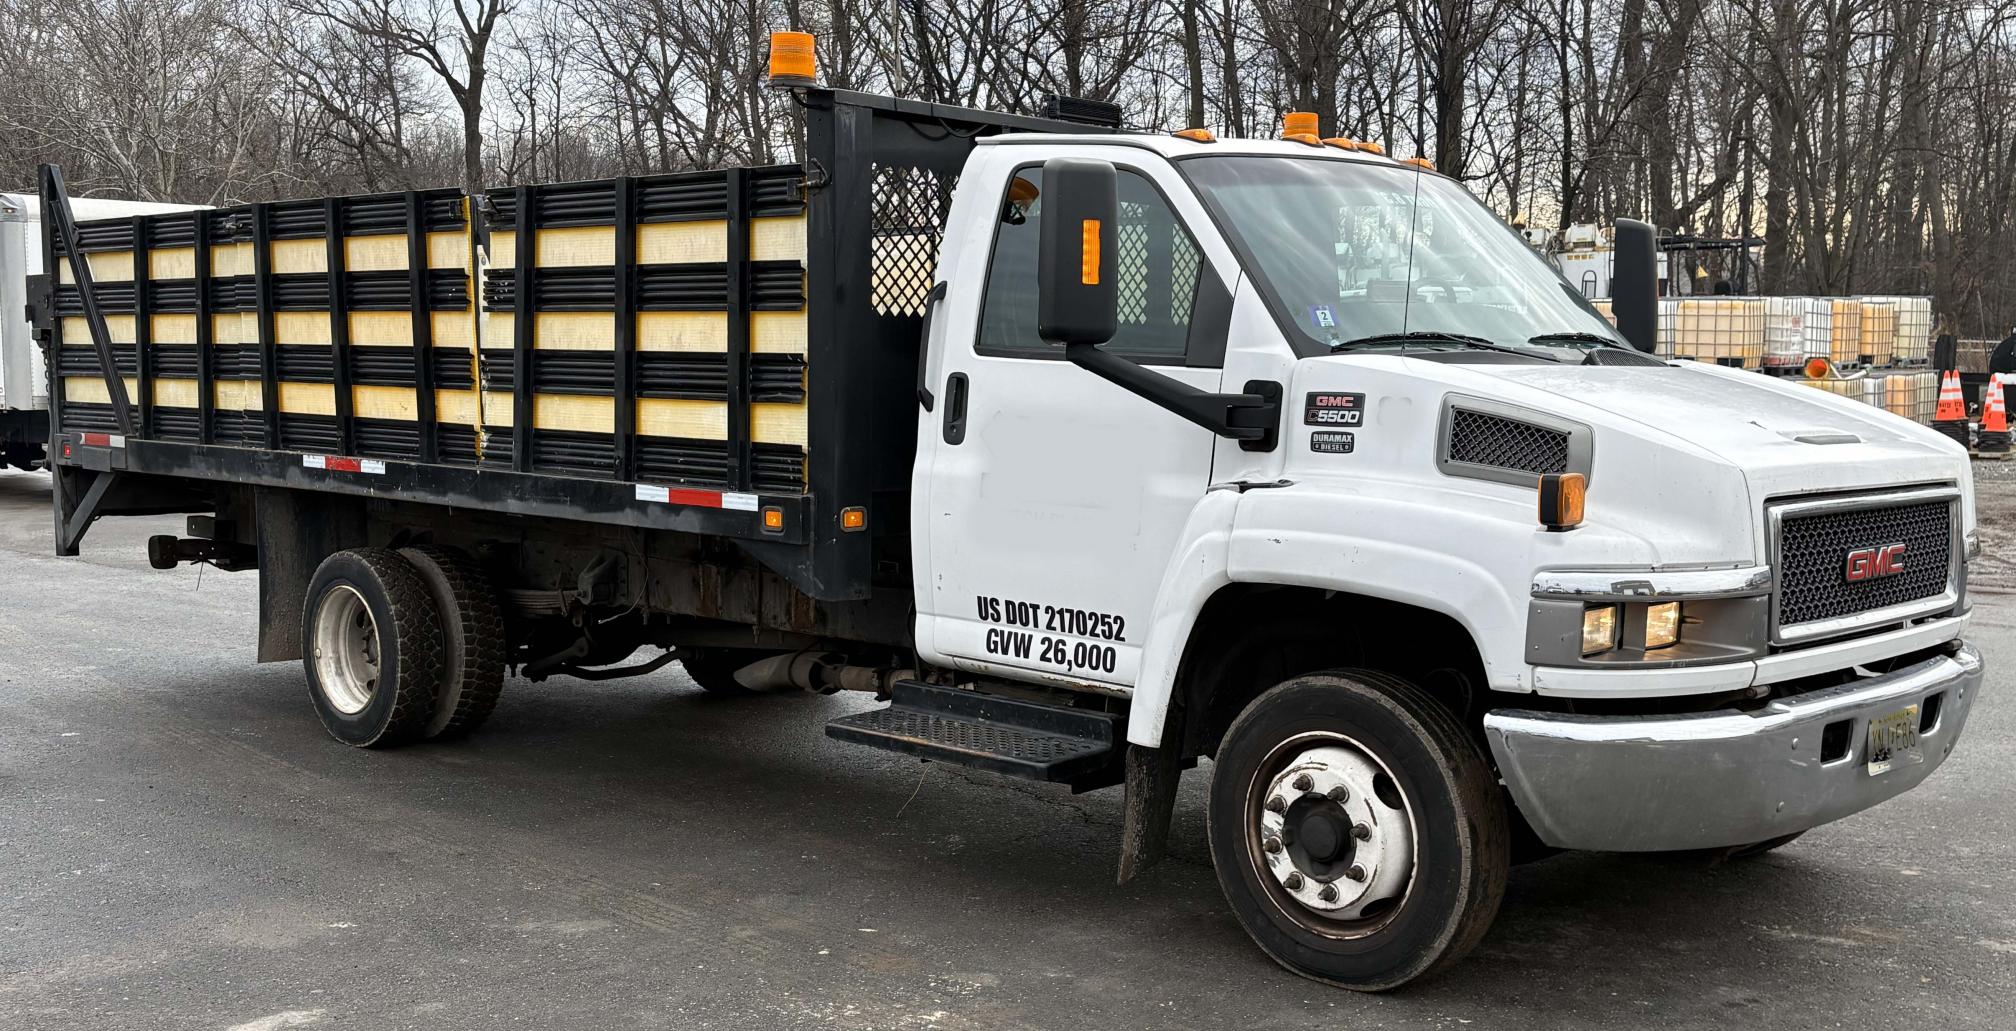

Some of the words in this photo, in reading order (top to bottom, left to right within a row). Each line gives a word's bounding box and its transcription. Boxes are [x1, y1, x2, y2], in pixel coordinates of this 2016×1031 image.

[1320, 311, 1329, 320] 2
[1316, 396, 1354, 407] GMC
[1307, 410, 1360, 423] C5500
[1313, 434, 1352, 443] DURAMAX
[1320, 443, 1343, 451] DIESEL
[1846, 543, 1905, 582] GMC
[977, 596, 1001, 623] US
[1004, 600, 1040, 628] DOT
[1045, 605, 1125, 642] 2170252
[986, 628, 1033, 659] GVW
[1040, 637, 1116, 673] 26,000
